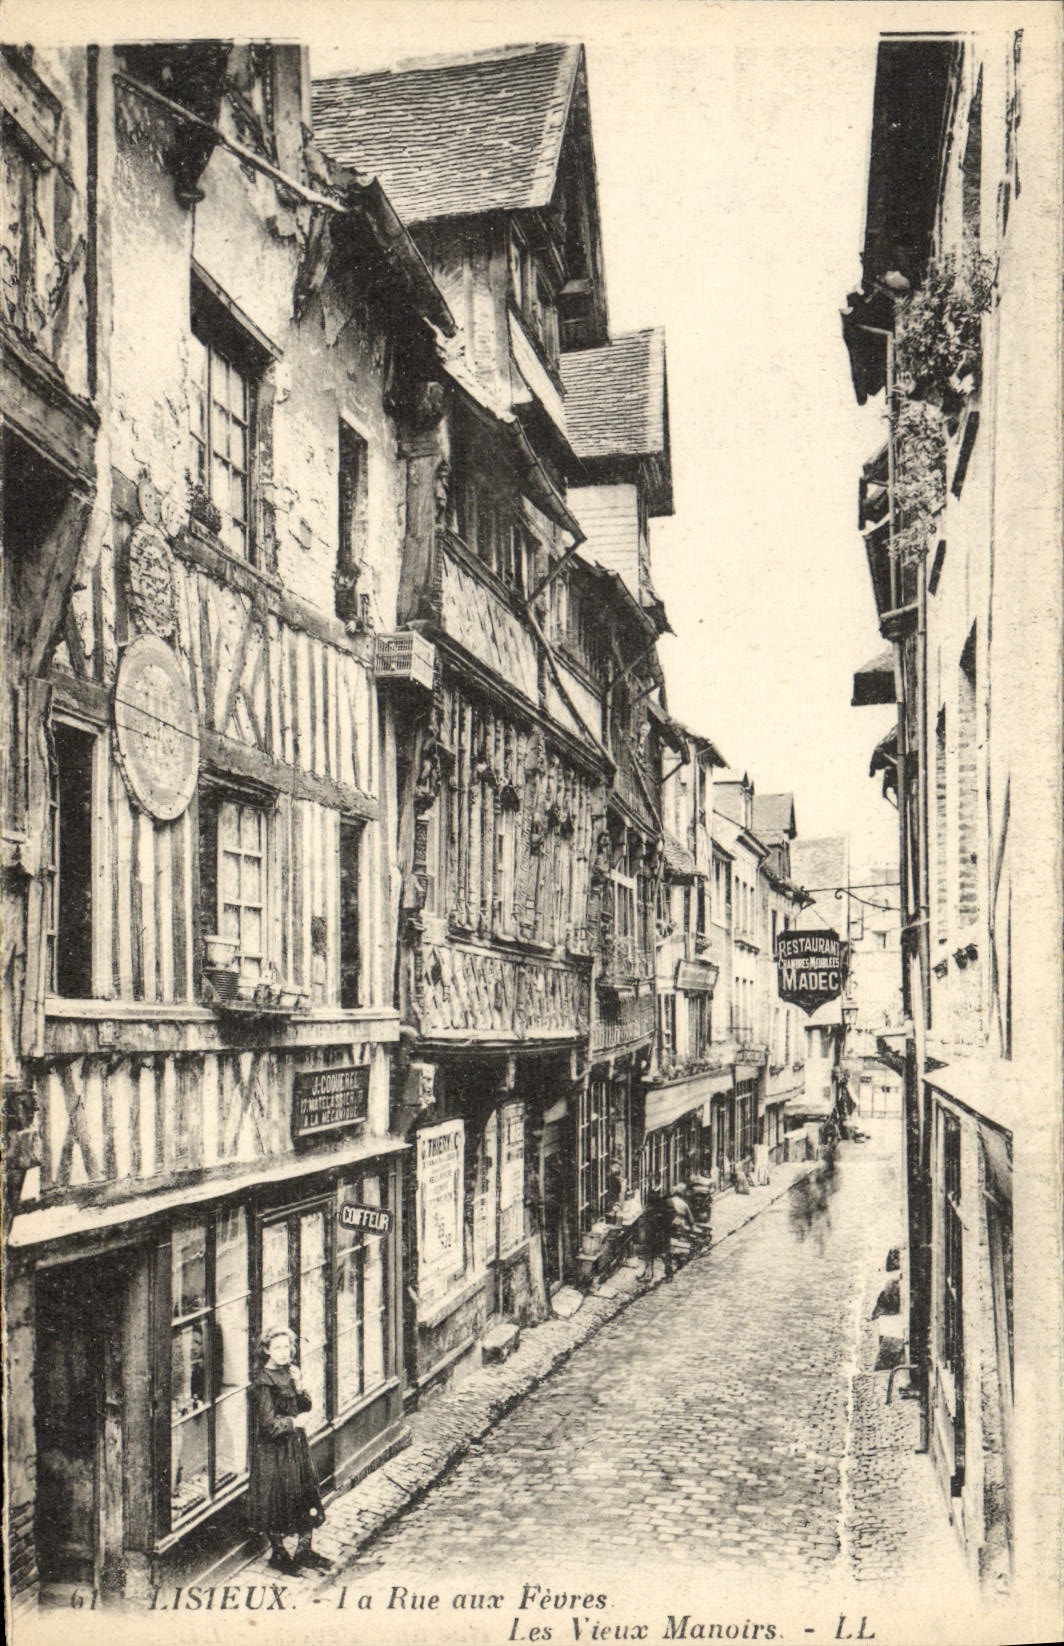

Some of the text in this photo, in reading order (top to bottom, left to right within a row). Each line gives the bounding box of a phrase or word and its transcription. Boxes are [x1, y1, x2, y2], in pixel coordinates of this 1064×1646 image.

[778, 937, 840, 959] RESTAURANT
[782, 967, 839, 991] MADEC
[342, 1205, 390, 1232] COIFFEUR
